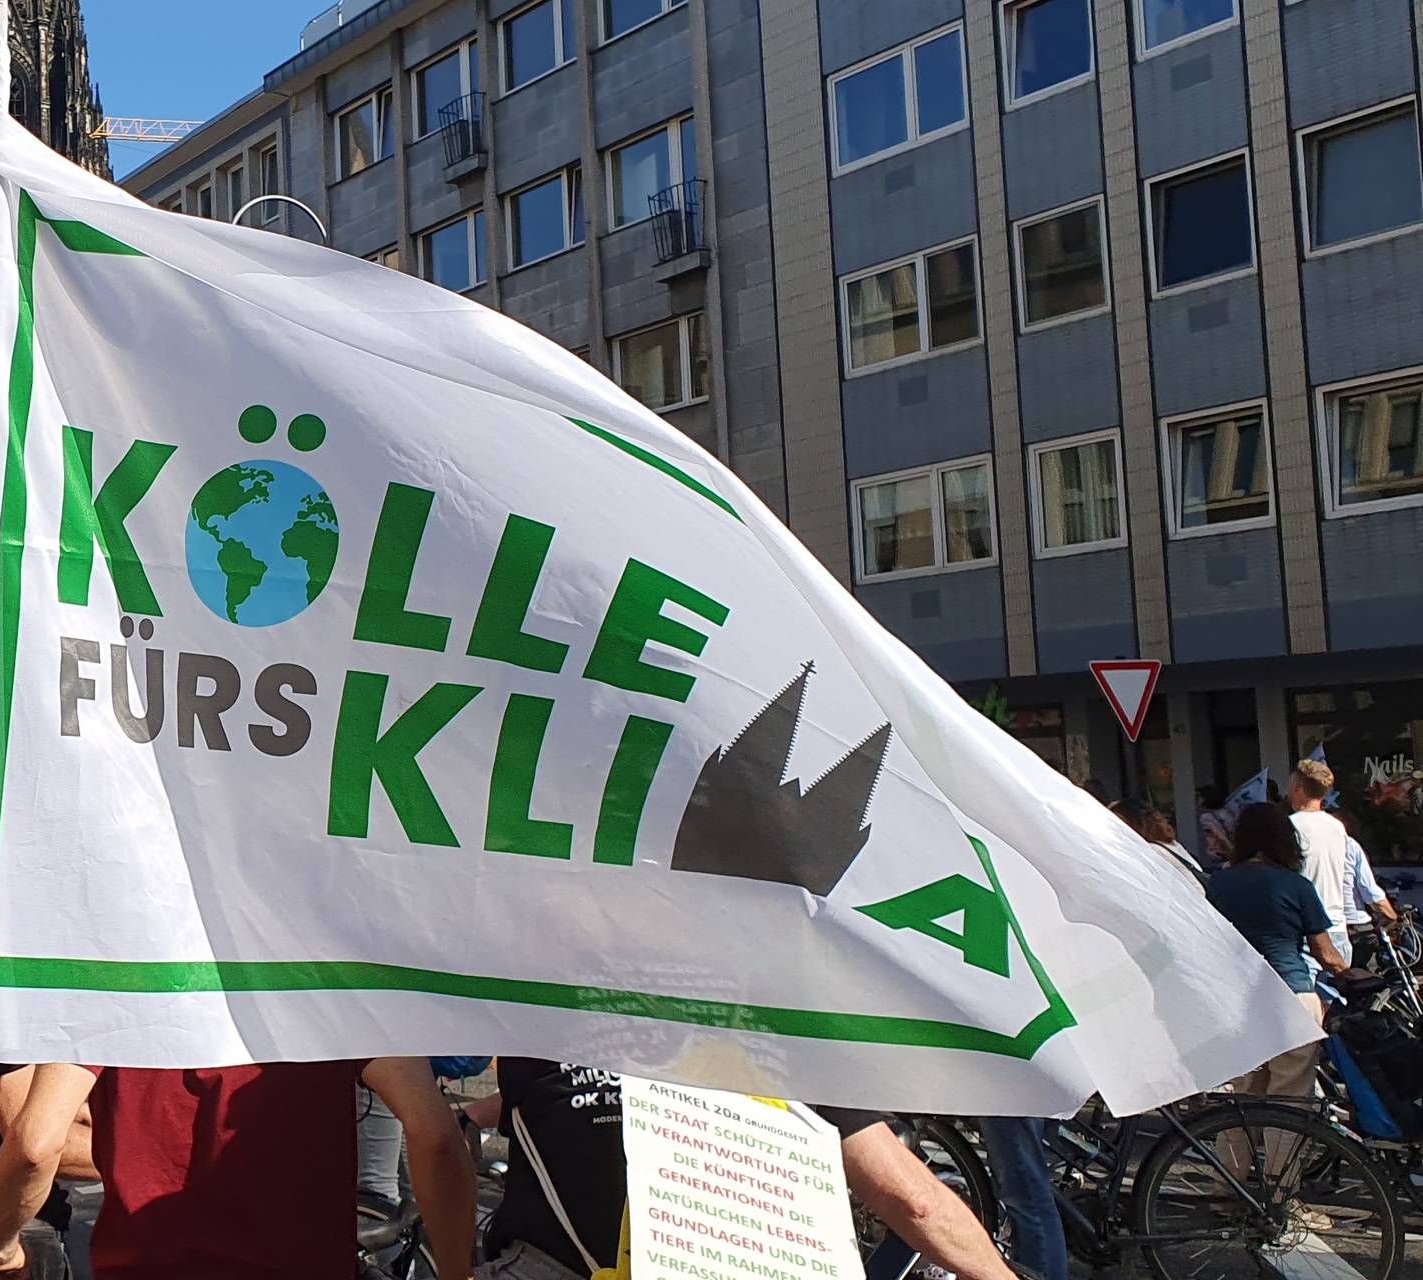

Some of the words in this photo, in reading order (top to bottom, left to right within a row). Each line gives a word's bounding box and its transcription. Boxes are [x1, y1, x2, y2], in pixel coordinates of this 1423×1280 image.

[58, 405, 730, 703] KÖLLE
[60, 616, 318, 757] FÜRS
[1364, 754, 1415, 780] Nails
[571, 1092, 599, 1109] OK
[605, 1091, 622, 1105] K
[649, 1083, 710, 1112] ARTIKEL
[714, 1104, 741, 1122] 20a
[745, 1118, 809, 1145] GRUNDGESETZ
[629, 1096, 660, 1115] DER
[664, 1108, 709, 1132] STAAT
[714, 1125, 783, 1156] SCHÜTZT
[788, 1151, 832, 1173] AUCH
[630, 1116, 646, 1131] IN
[651, 1123, 799, 1184] VERANTWORTUNG
[804, 1175, 835, 1195] FÜR
[658, 1167, 784, 1217] GENERATIONEN
[789, 1210, 815, 1228] DIE
[673, 1152, 698, 1169] DIE
[704, 1161, 795, 1201] KÜNFTIGEN
[648, 1185, 762, 1232] NATÜRLICHEN
[767, 1224, 833, 1253] LEBENS-
[648, 1207, 764, 1254] GRUNDLAGEN
[769, 1246, 806, 1267] UND
[811, 1259, 839, 1277] DIE
[649, 1229, 695, 1254] TIERE
[700, 1245, 722, 1263] IM
